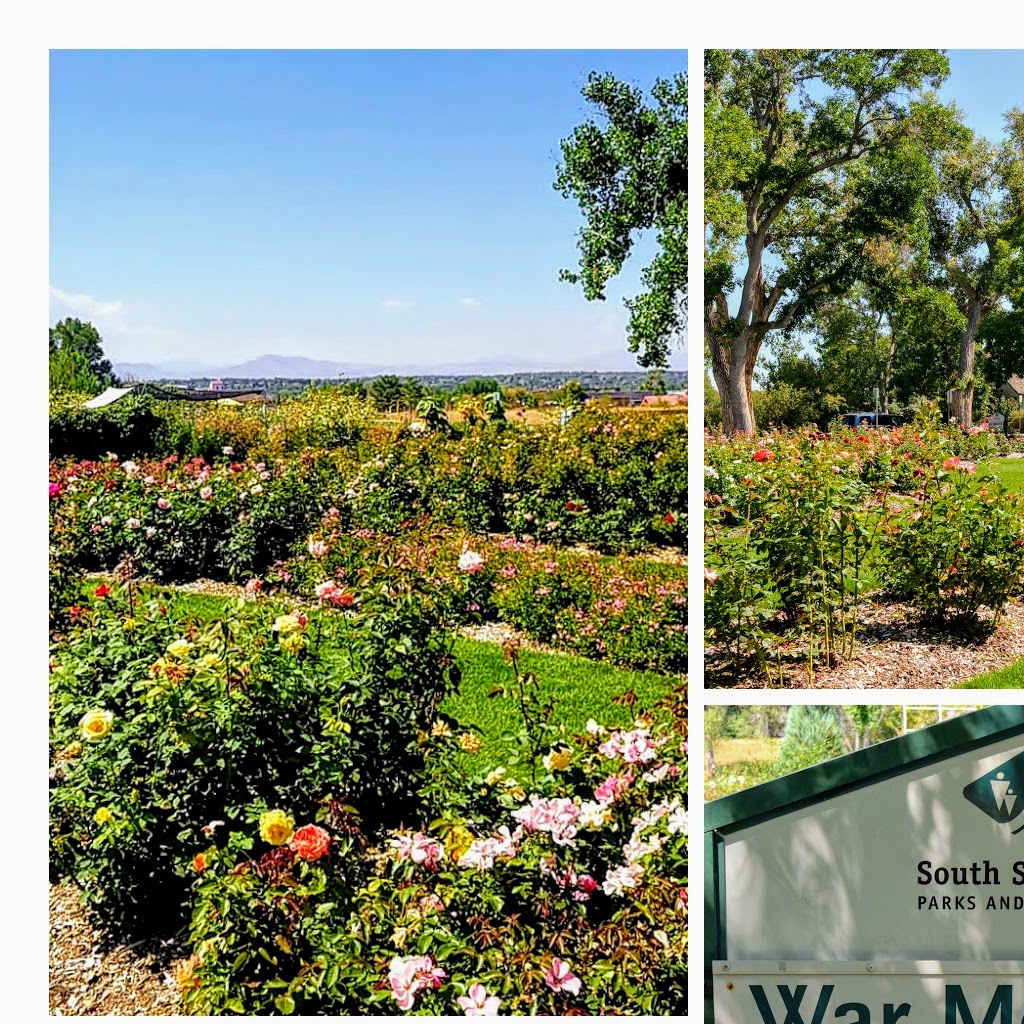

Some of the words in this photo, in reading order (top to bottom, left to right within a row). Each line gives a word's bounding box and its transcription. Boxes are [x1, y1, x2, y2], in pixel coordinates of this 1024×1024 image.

[917, 860, 1001, 886] South
[917, 895, 977, 911] PARKS
[985, 895, 1024, 911] AND
